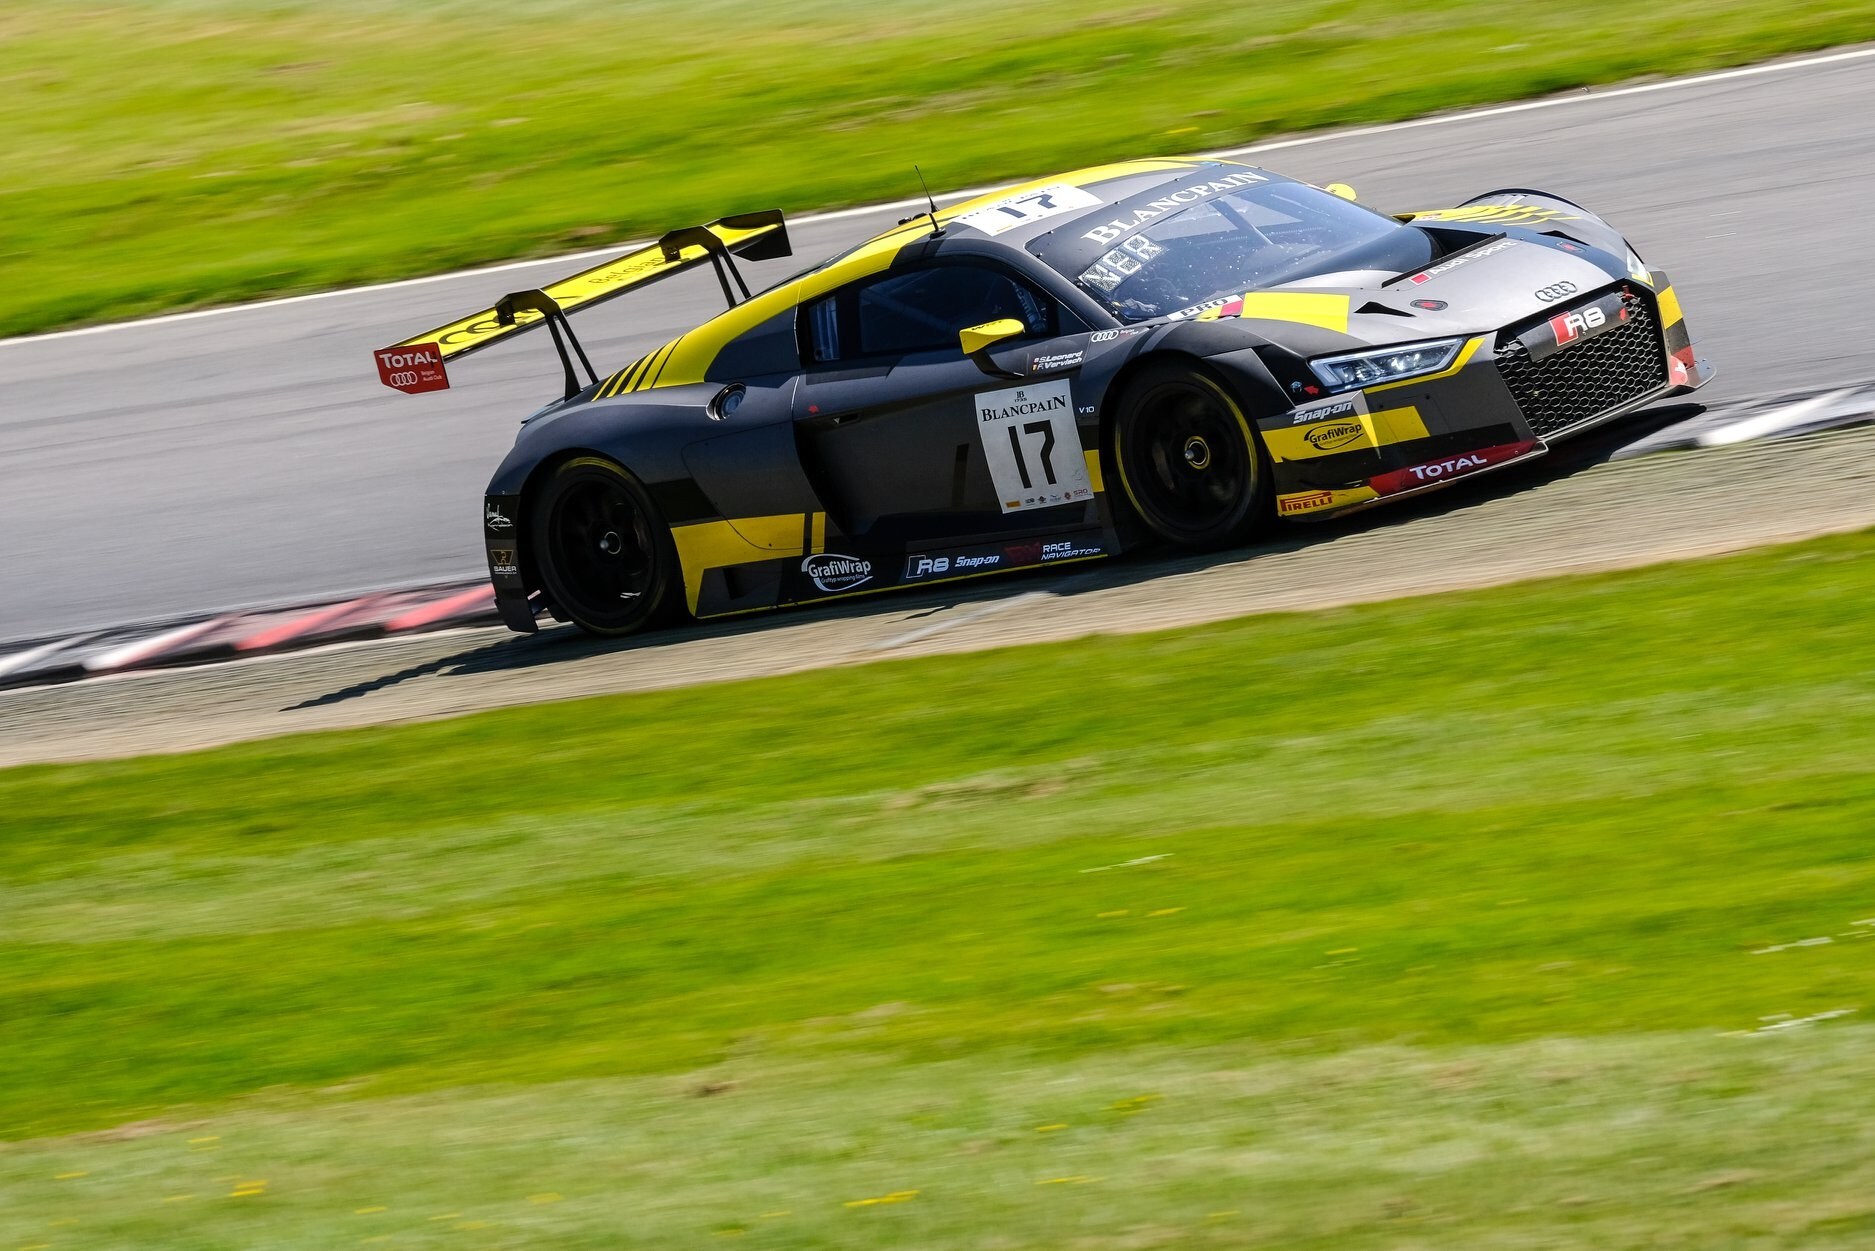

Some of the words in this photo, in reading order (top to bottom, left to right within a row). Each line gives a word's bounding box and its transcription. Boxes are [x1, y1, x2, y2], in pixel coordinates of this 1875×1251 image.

[996, 193, 1058, 219] 17
[1081, 171, 1269, 245] BLANCPAIN
[1429, 258, 1469, 275] Audi
[1465, 241, 1518, 259] Sport
[1180, 298, 1229, 317] PRO
[1563, 306, 1606, 337] R8
[379, 351, 438, 369] TOTAL
[981, 395, 1067, 422] BLANCPAIN
[1293, 400, 1353, 425] Snap-on
[1309, 423, 1362, 444] GrafiWrap
[1007, 419, 1058, 489] 17
[1409, 455, 1488, 480] TOTAL
[1280, 491, 1333, 512] PIRELLI
[1042, 541, 1072, 553] RACE
[808, 560, 872, 578] GrafiWrap
[916, 556, 950, 575] R8
[954, 555, 1001, 568] Snap-on
